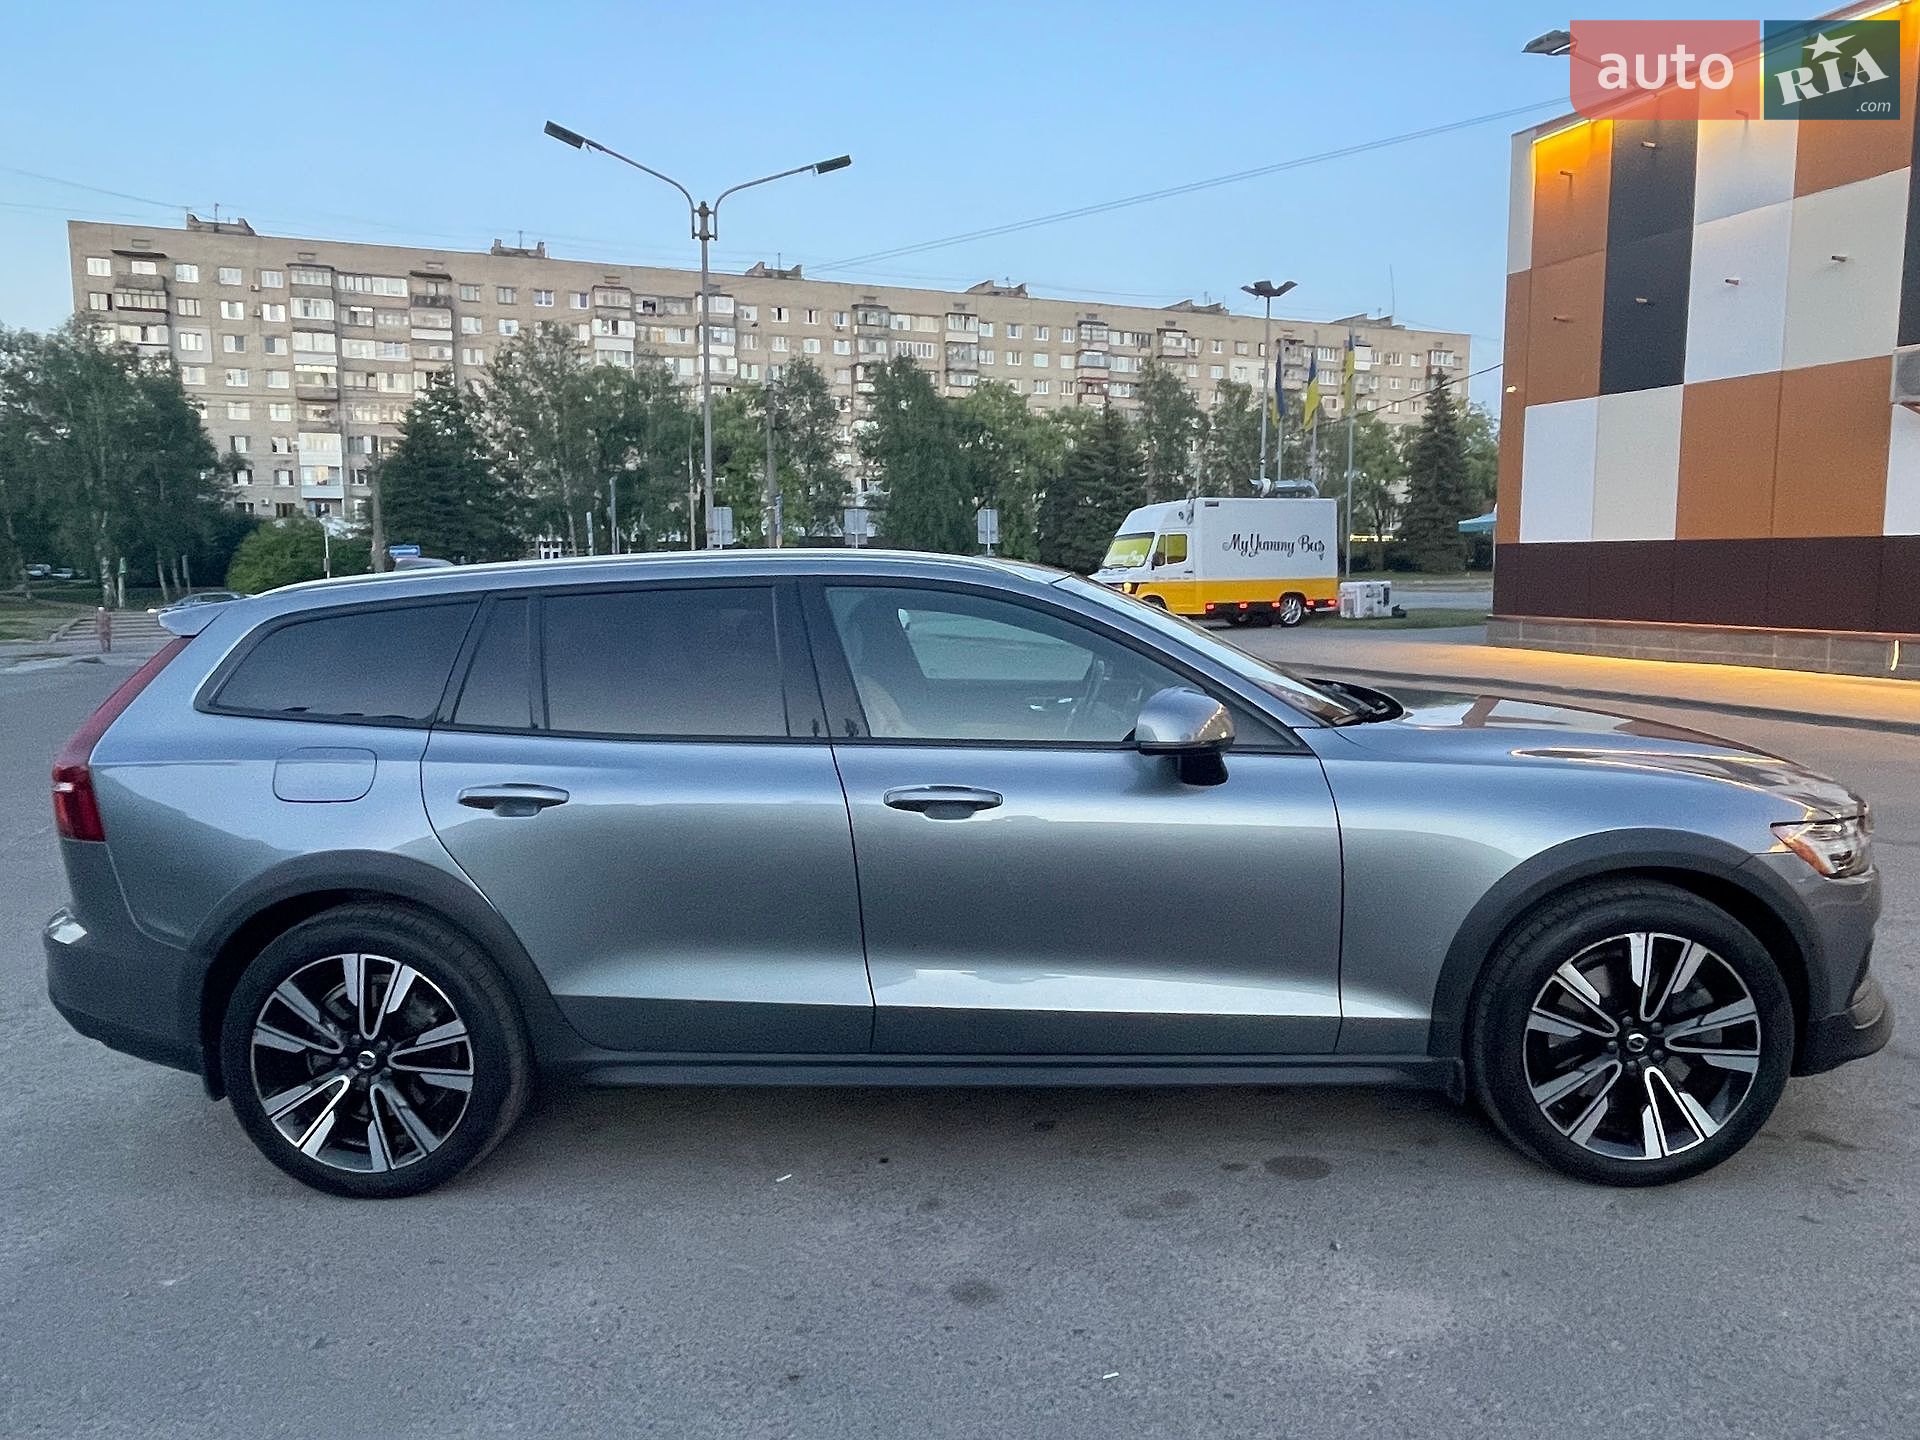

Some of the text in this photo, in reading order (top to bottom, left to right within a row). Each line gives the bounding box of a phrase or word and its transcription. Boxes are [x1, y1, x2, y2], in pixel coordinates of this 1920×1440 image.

[1222, 533, 1325, 558] My Yummy Bus
